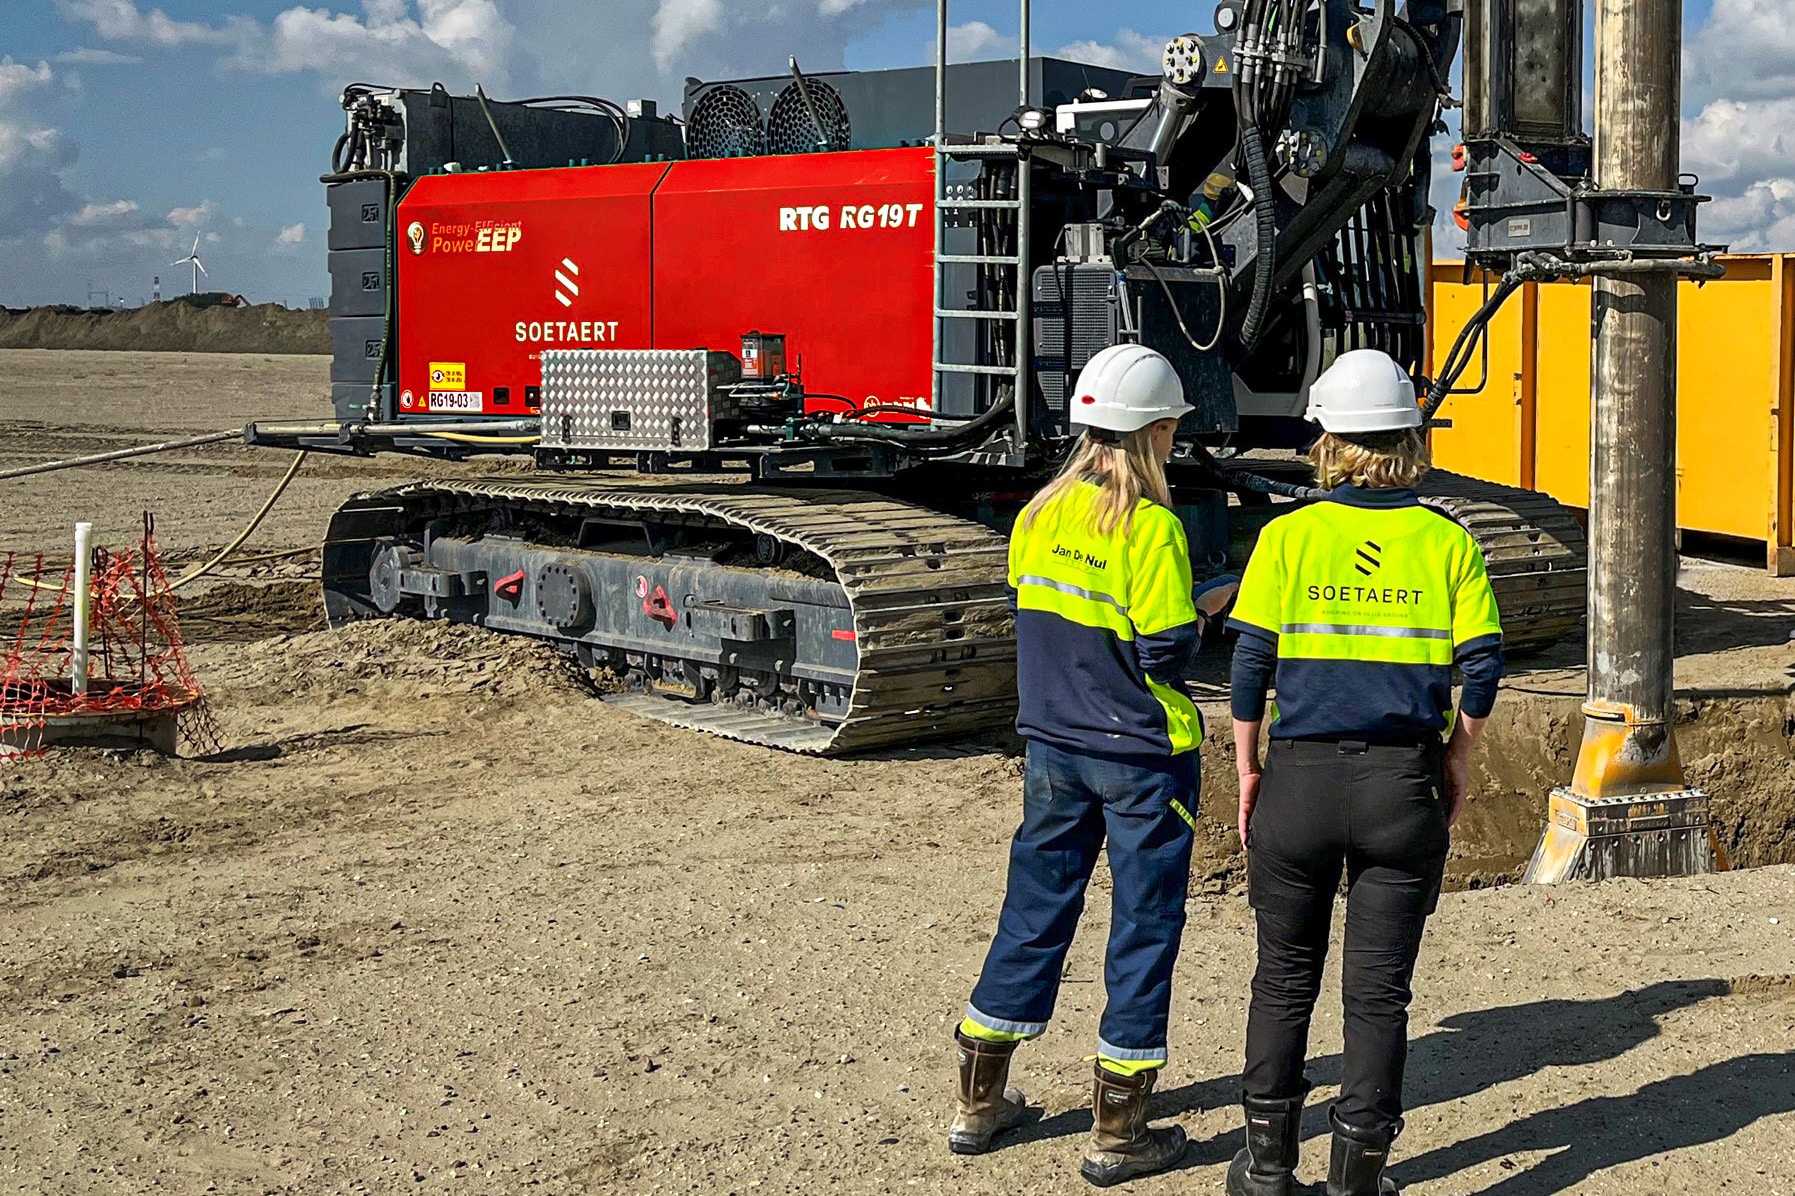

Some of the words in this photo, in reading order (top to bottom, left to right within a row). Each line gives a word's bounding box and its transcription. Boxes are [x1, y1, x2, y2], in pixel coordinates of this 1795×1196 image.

[779, 205, 830, 231] RTG
[476, 227, 522, 252] EEP
[515, 321, 619, 342] SOETAERT
[430, 393, 468, 408] RG19-03
[1052, 544, 1072, 558] Jan
[1074, 549, 1083, 562] De
[1085, 553, 1107, 570] Nul
[1308, 585, 1423, 605] SOETAERT
